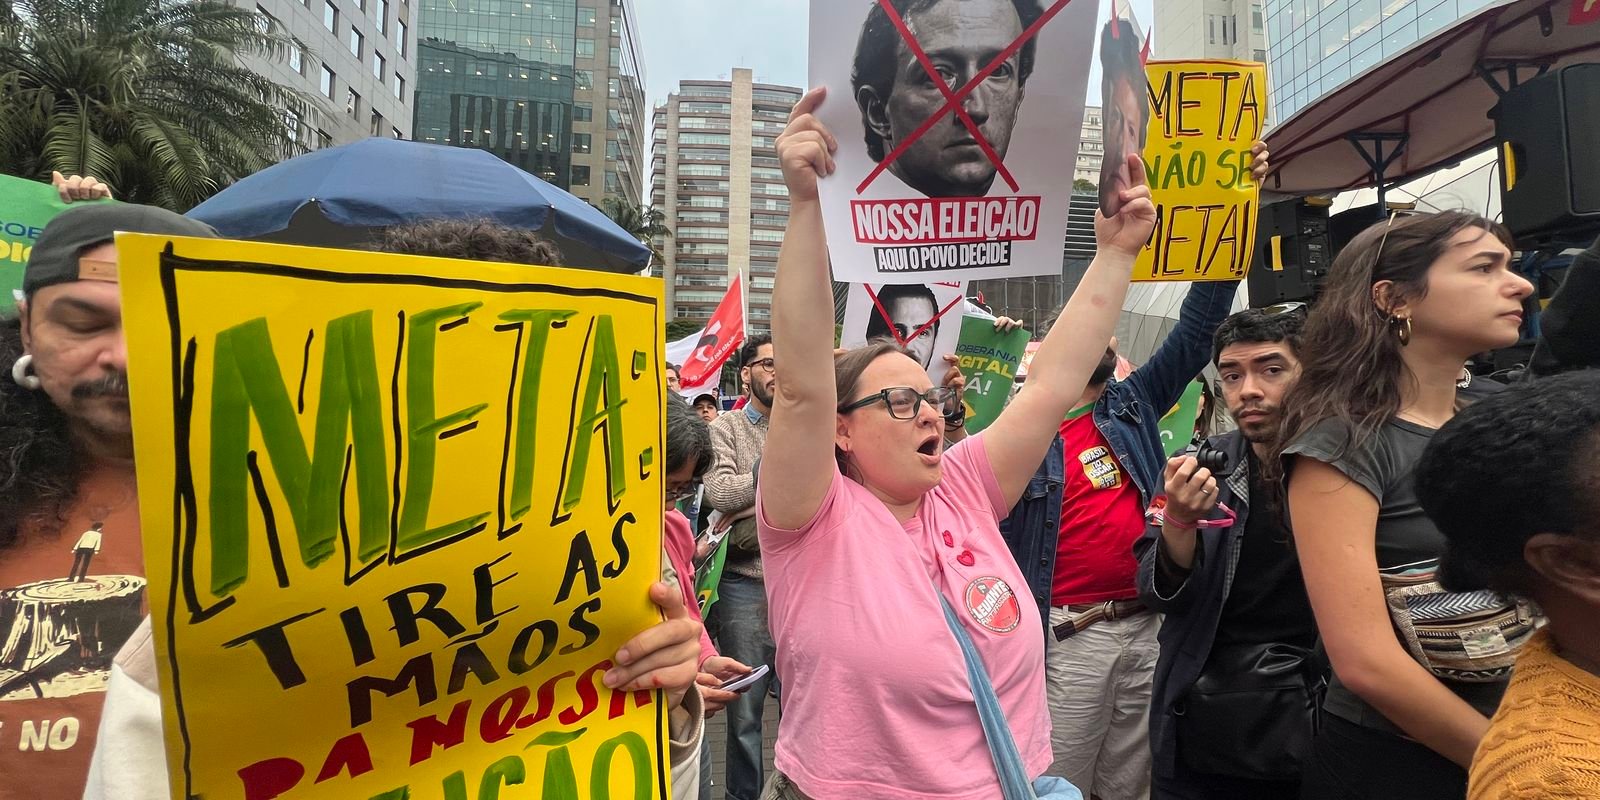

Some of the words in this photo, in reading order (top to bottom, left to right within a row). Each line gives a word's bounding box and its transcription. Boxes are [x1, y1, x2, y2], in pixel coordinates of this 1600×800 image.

[1147, 71, 1258, 142] META
[1143, 141, 1206, 190] NÃO
[854, 202, 935, 241] NOSSA
[939, 197, 1036, 241] ELEIÇÃO
[878, 247, 909, 272] AQUI
[909, 248, 920, 270] O
[921, 245, 956, 269] POVO
[960, 241, 1009, 266] DECIDE
[957, 343, 1018, 365] OBERANIA
[190, 302, 653, 612] META:
[1081, 447, 1106, 464] BRASIL
[222, 552, 519, 690] TIRE
[554, 512, 637, 605] AS
[971, 579, 1009, 620] LEVANTE
[346, 598, 602, 728] MÃOS
[18, 716, 80, 751] NO
